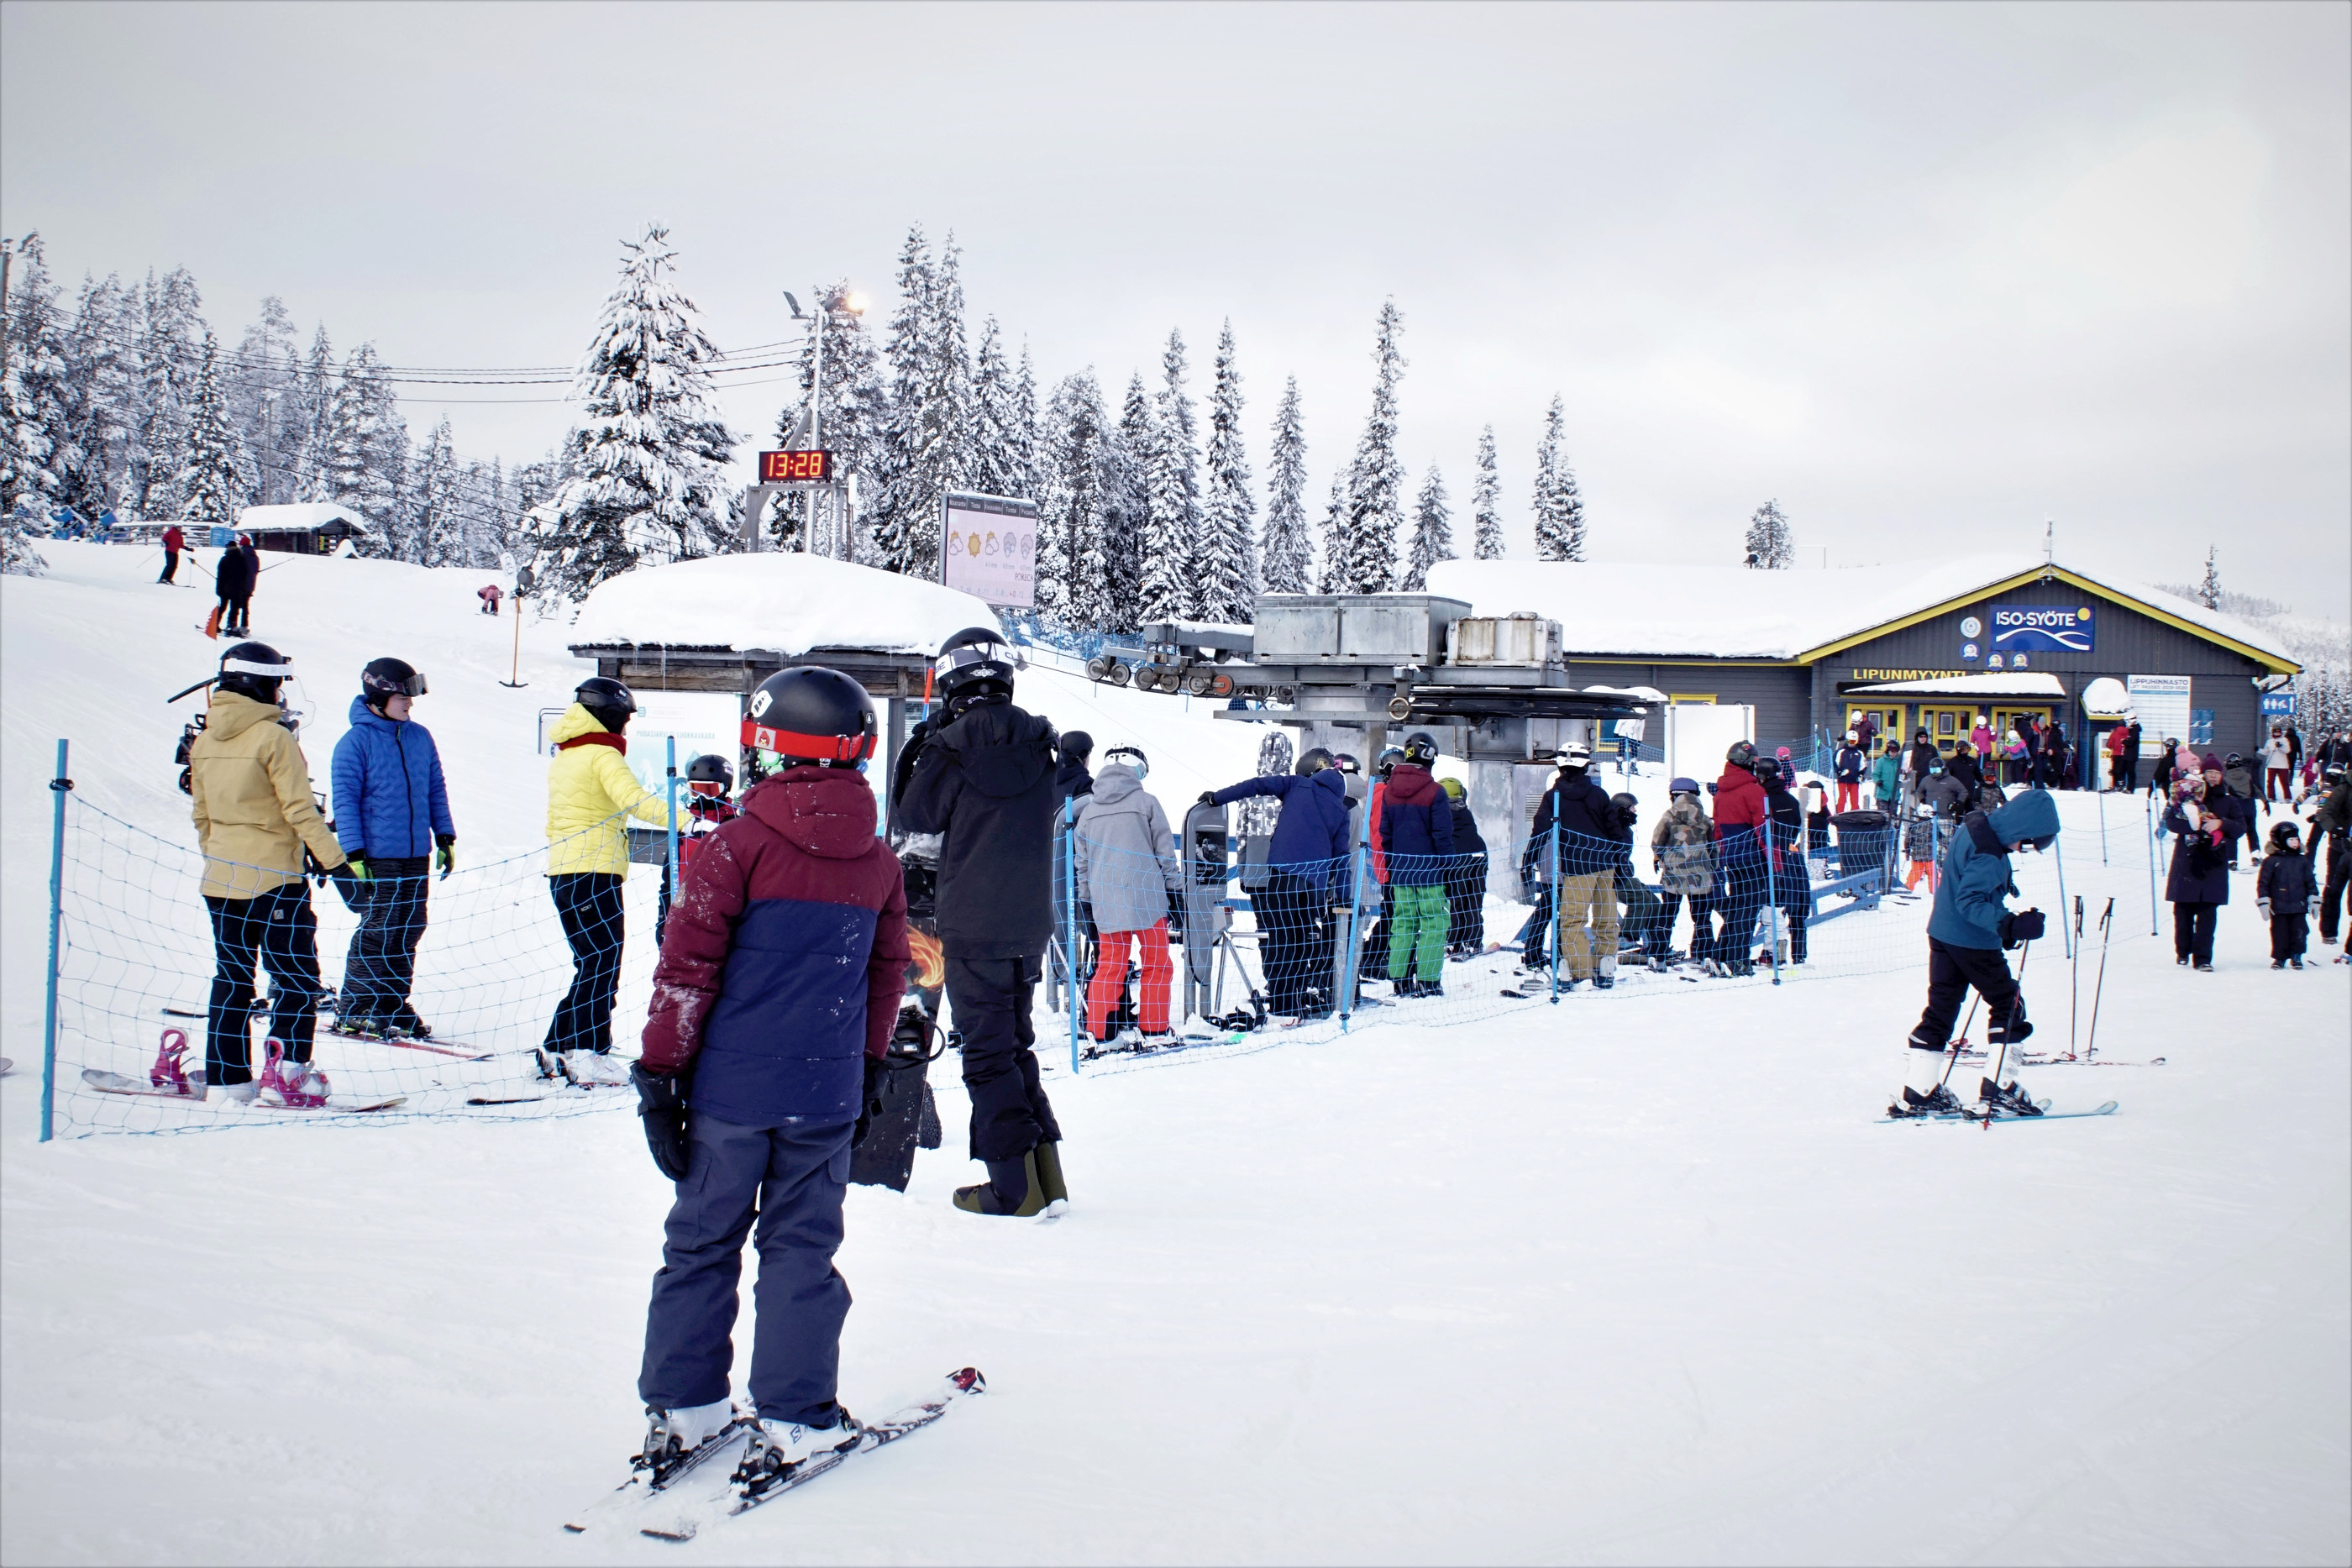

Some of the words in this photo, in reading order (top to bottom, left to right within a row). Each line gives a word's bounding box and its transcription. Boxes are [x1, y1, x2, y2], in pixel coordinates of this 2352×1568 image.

[769, 453, 822, 477] 13:28
[1015, 573, 1033, 582] FORECA
[1996, 611, 2076, 627] ISO-SYÖTE
[250, 664, 287, 674] GIRO
[1853, 669, 1967, 681] LIPUNMYYNTI
